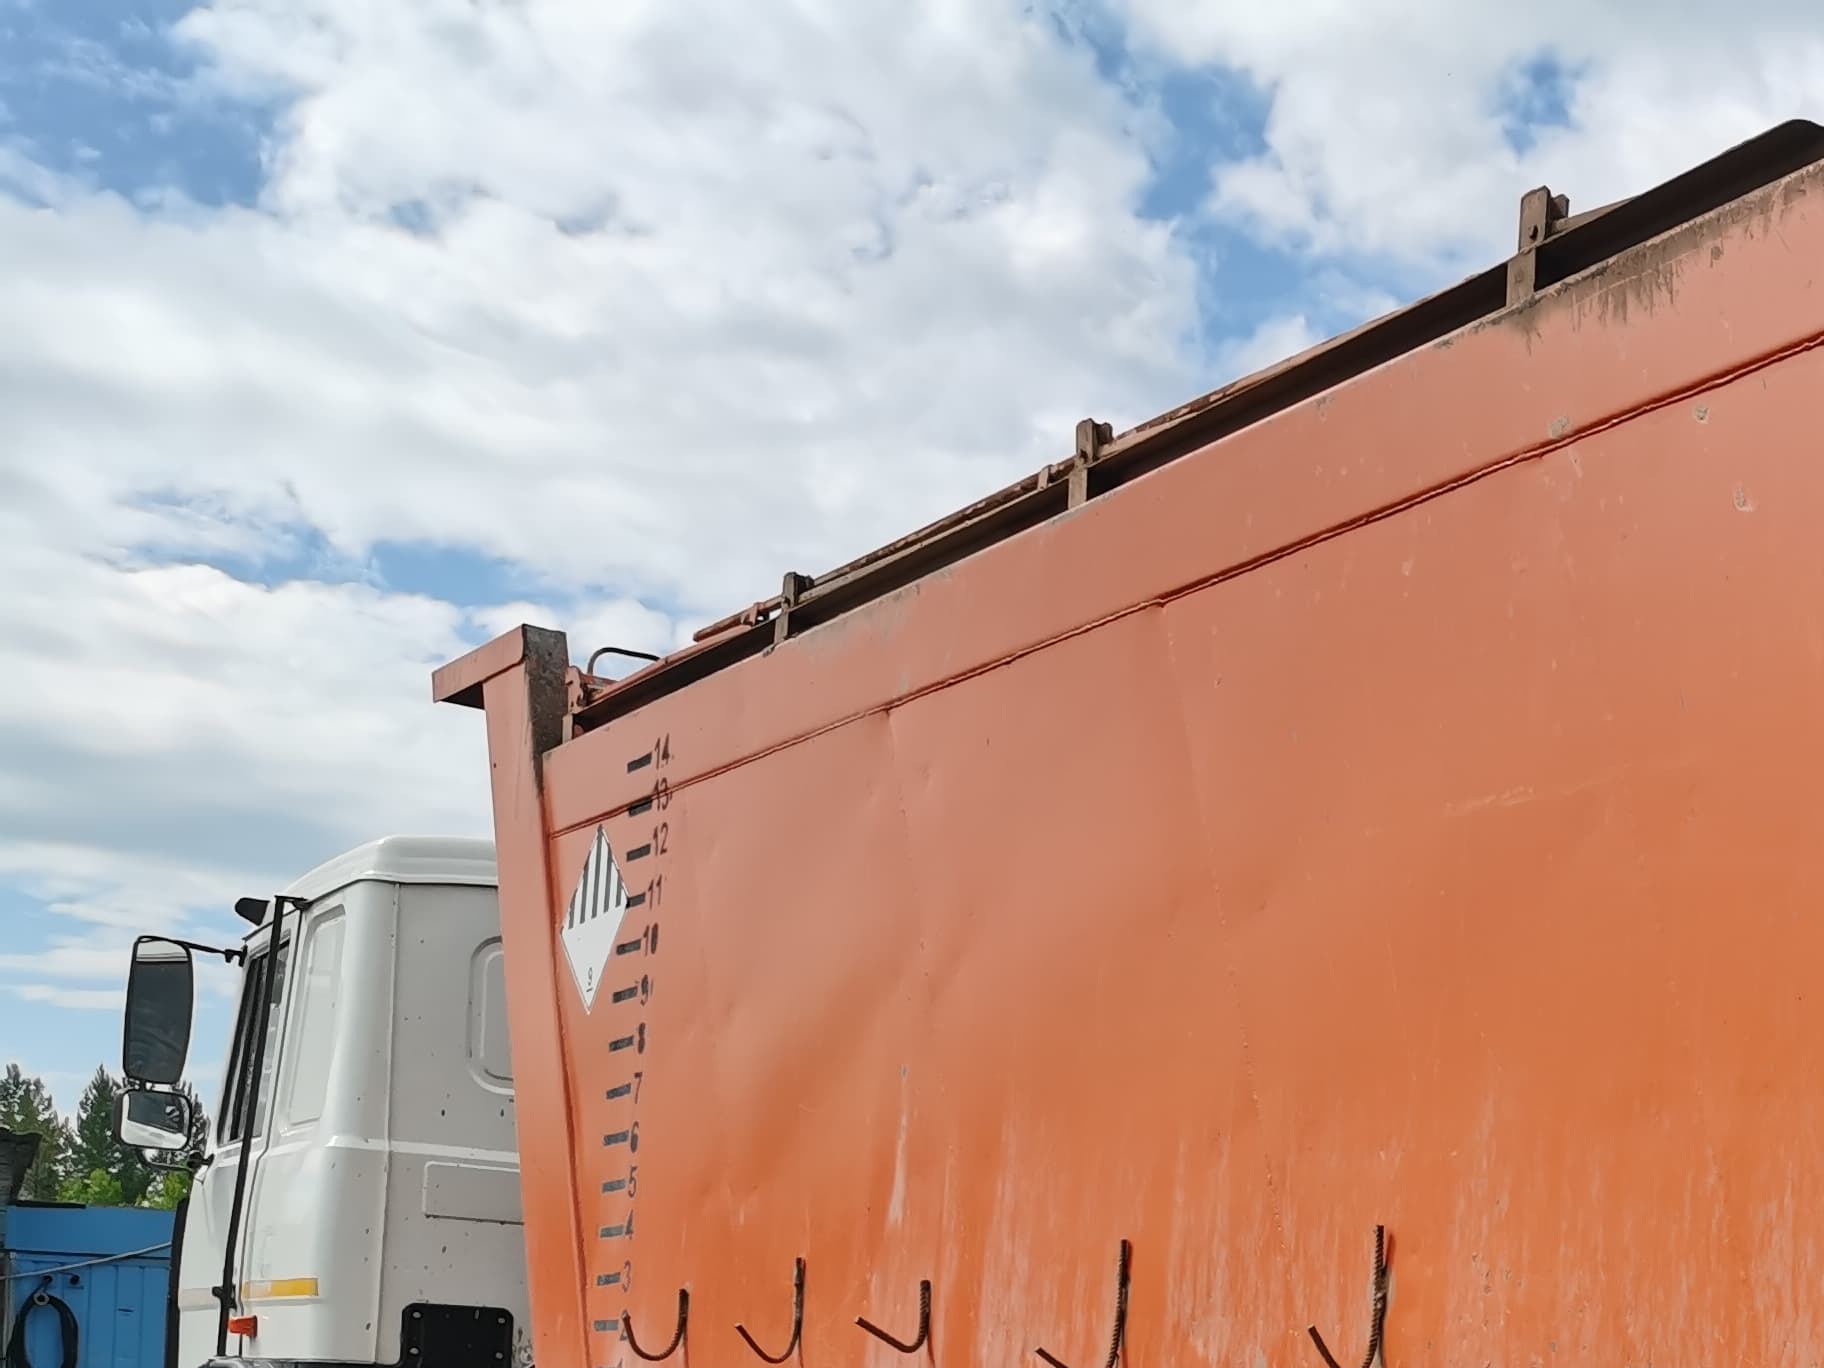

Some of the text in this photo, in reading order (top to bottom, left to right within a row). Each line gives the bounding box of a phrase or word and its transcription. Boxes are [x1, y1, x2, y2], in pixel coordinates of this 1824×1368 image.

[653, 733, 671, 769] 14
[653, 822, 669, 856] 12
[648, 874, 663, 910] 11
[643, 922, 659, 956] 10
[637, 1022, 646, 1054] 8
[634, 1072, 643, 1104] 7
[630, 1121, 640, 1153] 6
[628, 1166, 638, 1198] 5
[624, 1209, 635, 1240] 4
[621, 1260, 632, 1292] 3
